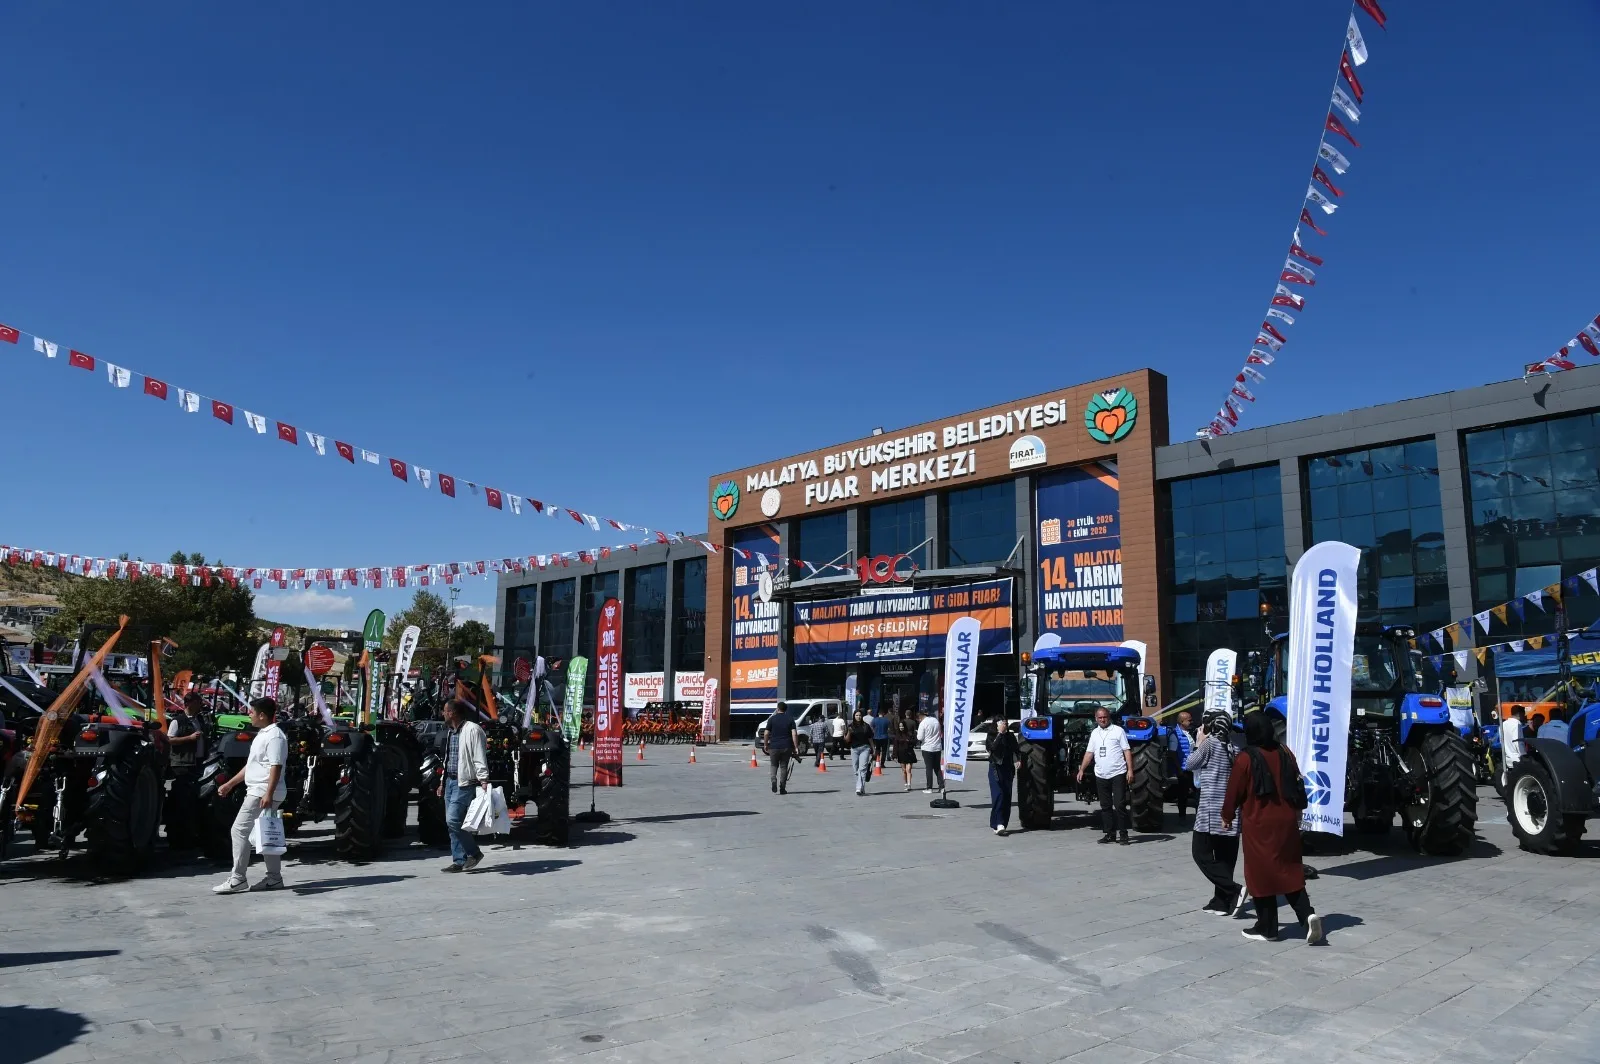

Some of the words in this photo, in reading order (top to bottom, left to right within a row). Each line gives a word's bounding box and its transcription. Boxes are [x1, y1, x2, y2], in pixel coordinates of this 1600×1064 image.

[746, 460, 820, 492] MALATYA
[824, 431, 937, 474] BÜYÜKŞEHİR
[943, 399, 1066, 448] BELEDİYESİ
[1010, 448, 1035, 460] FIRAT
[805, 475, 860, 506] FUAR
[872, 449, 976, 493] MERKEZİ
[1067, 520, 1075, 528] 30
[1076, 516, 1094, 527] EYLÜL
[1096, 515, 1114, 525] 2026
[1067, 530, 1072, 538] 4
[1073, 528, 1089, 537] EKİM
[1090, 526, 1107, 536] 2026
[1040, 556, 1075, 591] 14.
[1073, 548, 1121, 567] MALATYA
[1075, 563, 1122, 588] TARIM
[734, 595, 753, 620] 14.
[754, 602, 780, 618] TARIM
[812, 604, 847, 620] MALATYA
[849, 600, 874, 617] TARIM
[876, 595, 931, 614] HAYVANCILIK
[933, 593, 945, 609] VE
[947, 591, 969, 607] GIDA
[1044, 588, 1123, 610] HAYVANCILIK
[853, 624, 875, 638] HOŞ
[877, 617, 929, 633] GELDİNİZ
[1045, 612, 1058, 629] VE
[1062, 611, 1088, 628] GIDA
[1313, 568, 1338, 693] HOLLAND
[735, 637, 743, 649] VE
[745, 635, 760, 649] GIDA
[761, 635, 779, 648] FUAR
[610, 653, 619, 714] TRAKTÖR
[677, 673, 704, 686] SARIÇİÇ
[951, 631, 972, 757] KAZAKHANLAR
[1311, 699, 1331, 763] NEW
